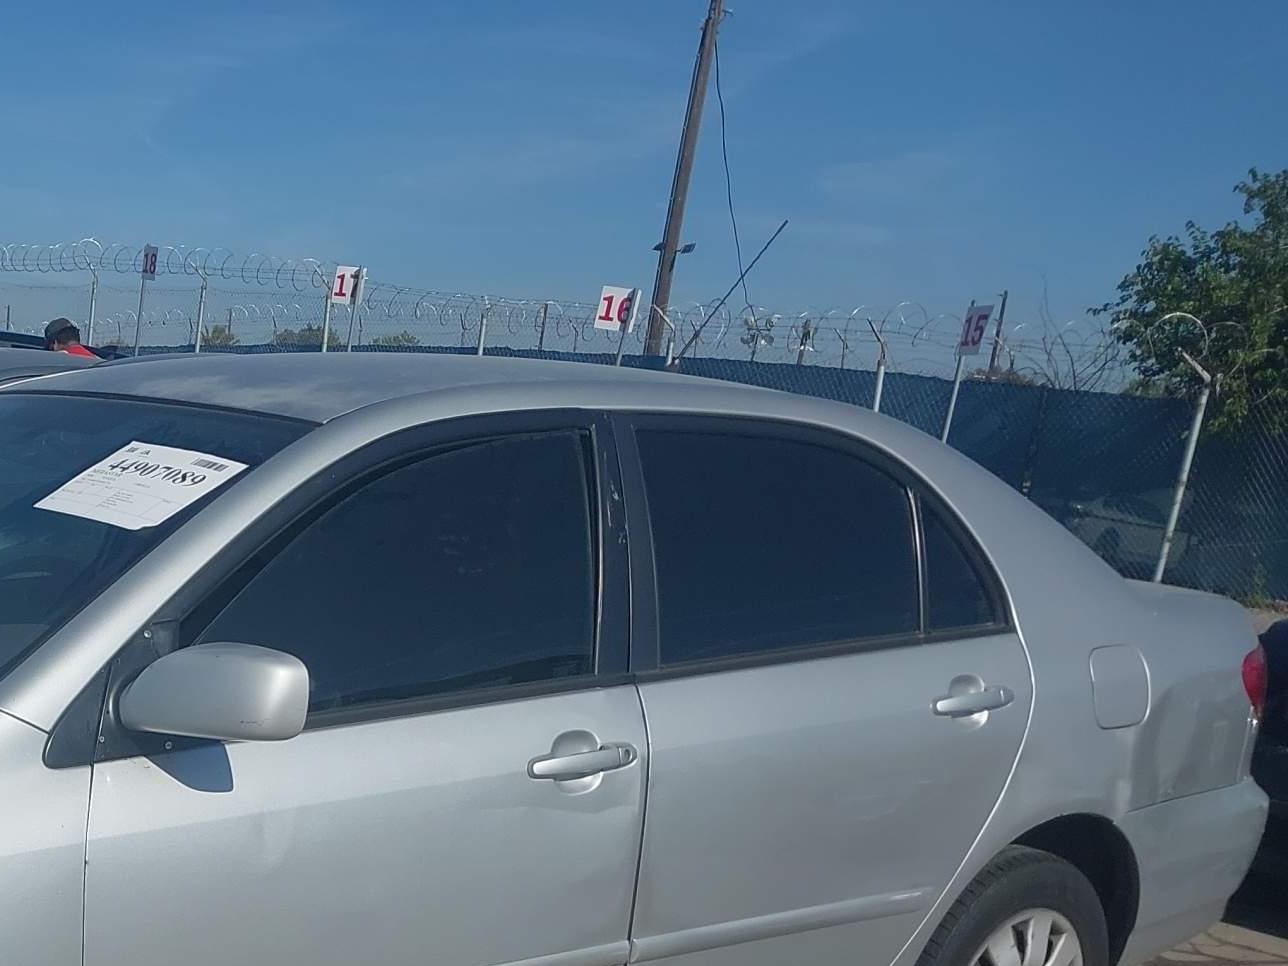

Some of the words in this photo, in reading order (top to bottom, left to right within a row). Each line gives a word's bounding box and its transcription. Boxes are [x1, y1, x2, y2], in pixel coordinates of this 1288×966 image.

[142, 253, 157, 274] 18
[598, 295, 632, 323] 16
[960, 314, 990, 346] 15
[107, 458, 207, 487] 44907089
